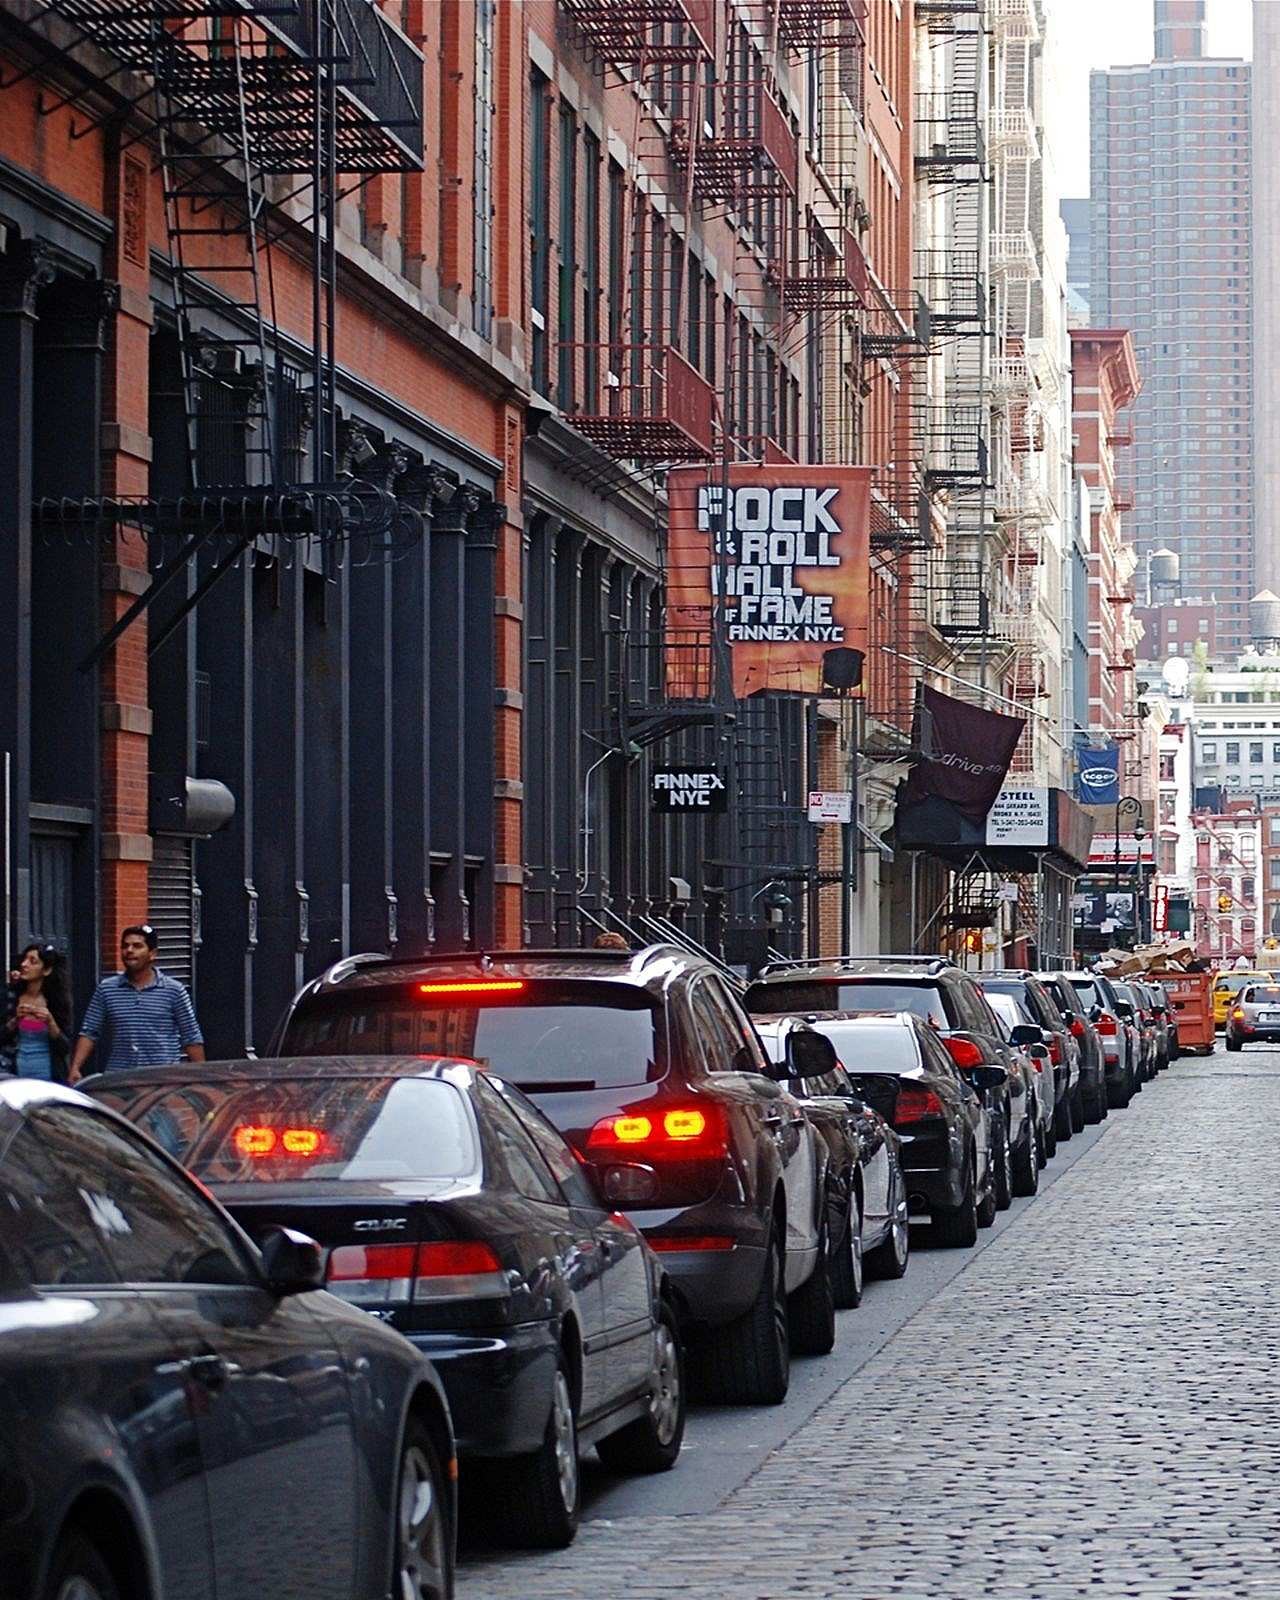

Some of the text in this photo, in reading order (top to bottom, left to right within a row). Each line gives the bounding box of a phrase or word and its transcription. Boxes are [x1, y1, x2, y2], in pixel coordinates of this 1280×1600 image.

[698, 487, 841, 532] ROCK
[741, 532, 840, 565] ROLL
[711, 565, 802, 596] HALL
[740, 597, 833, 624] FAME
[729, 625, 844, 642] ANNEX NYC
[942, 752, 984, 775] drive
[654, 774, 725, 789] ANNEX
[670, 790, 710, 805] NYC
[810, 794, 822, 805] NO
[1000, 791, 1036, 801] STEEL
[353, 1218, 408, 1231] CIVIC
